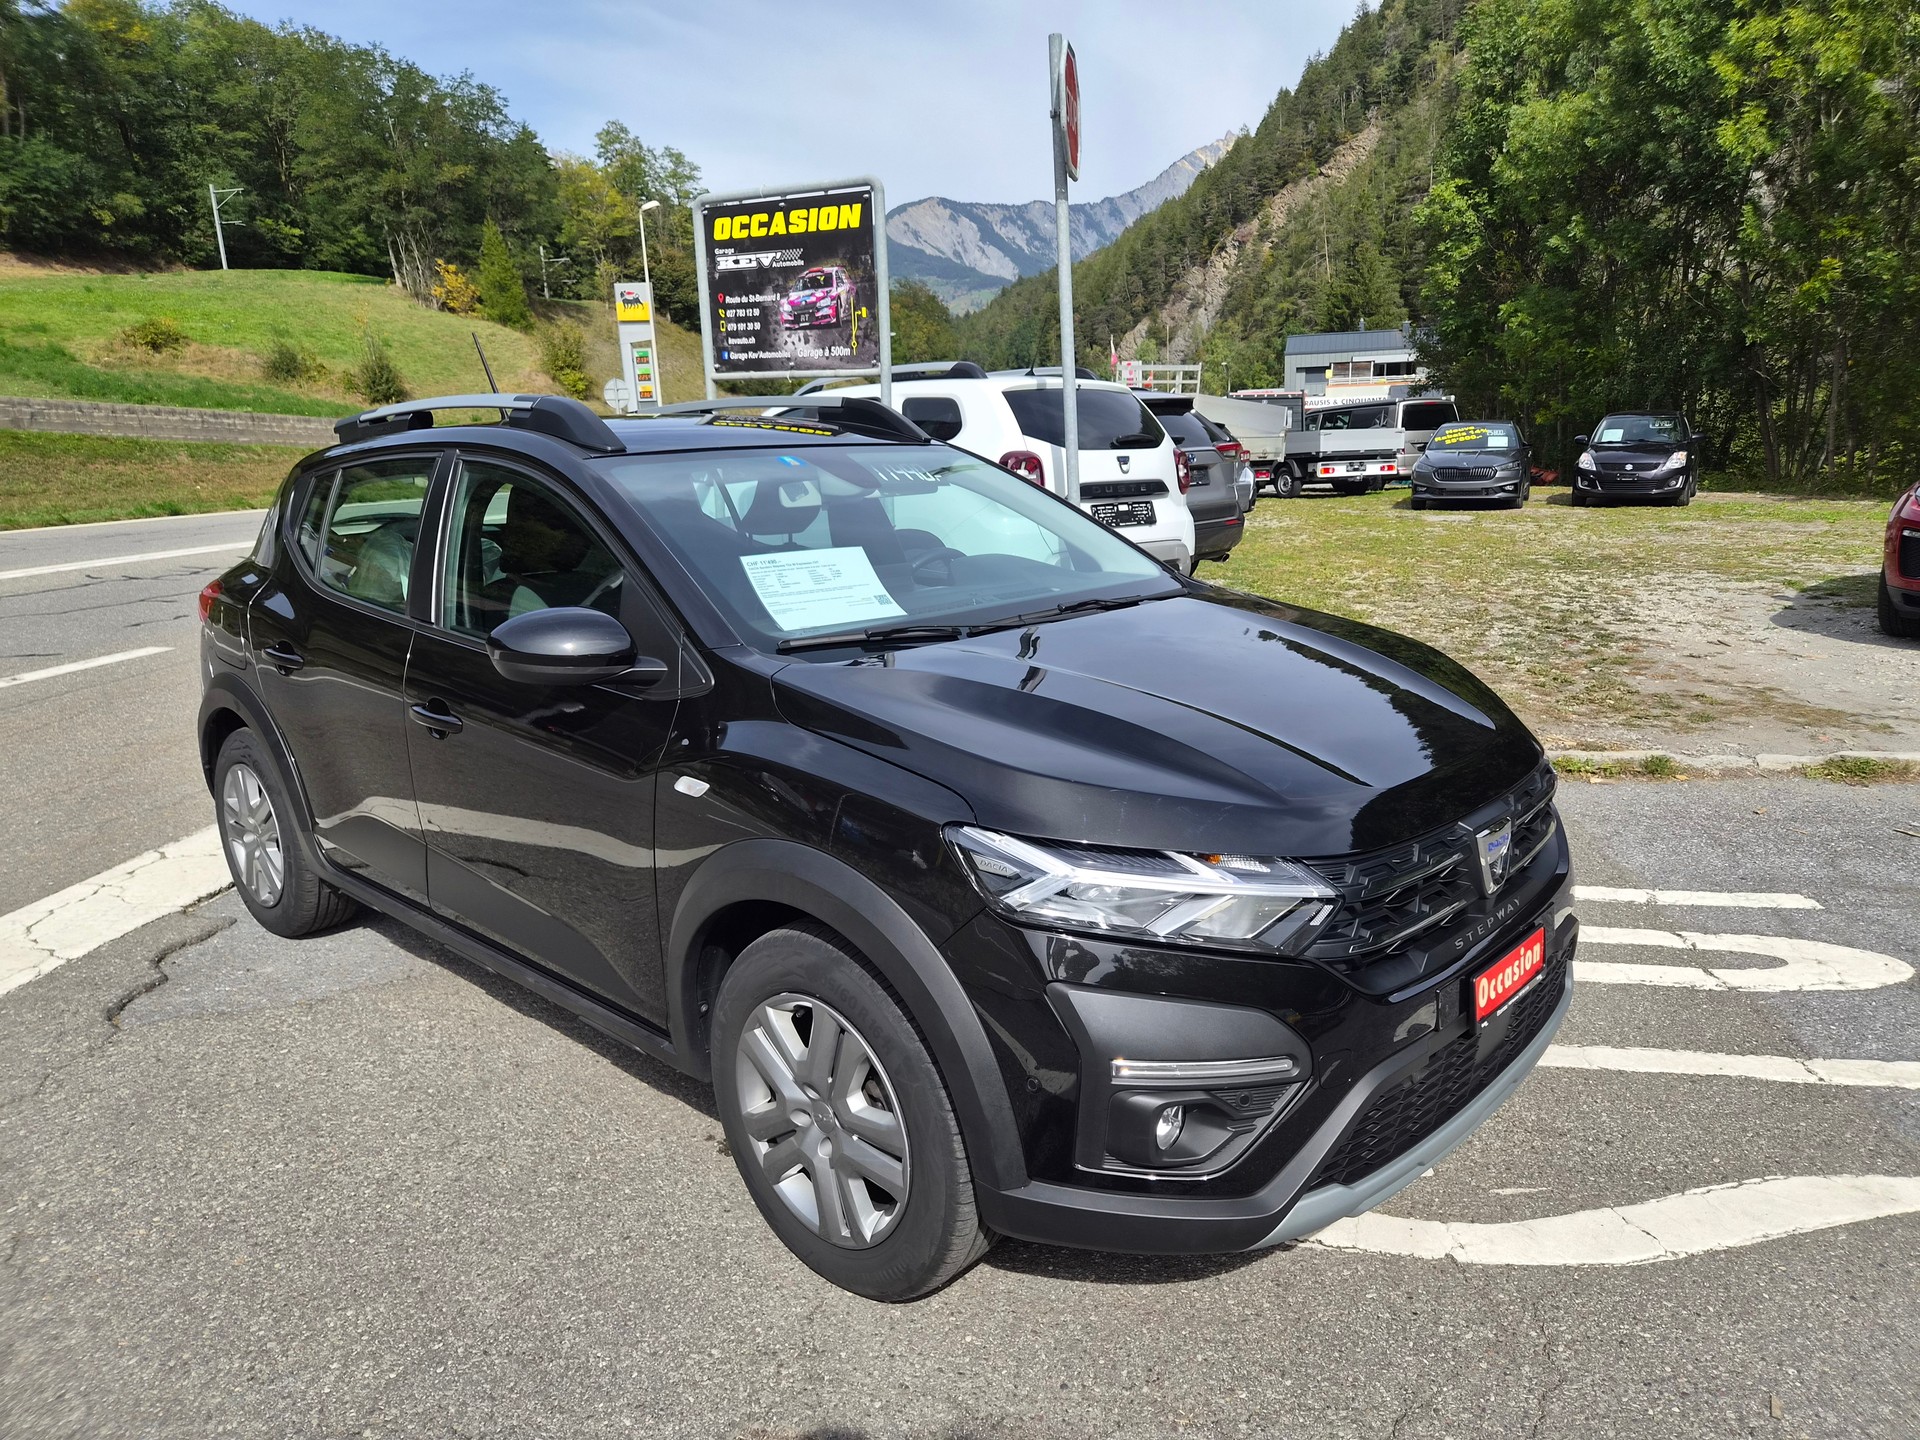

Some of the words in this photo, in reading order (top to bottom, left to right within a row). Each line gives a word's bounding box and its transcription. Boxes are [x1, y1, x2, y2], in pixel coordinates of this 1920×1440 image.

[713, 203, 863, 241] OCCASION
[772, 259, 805, 268] Automobile
[725, 295, 741, 304] Route
[741, 295, 748, 303] du
[748, 292, 776, 303] St-Bernard
[729, 352, 748, 361] Garage
[797, 347, 824, 359] Garage
[830, 346, 851, 357] 500m
[979, 859, 1009, 873] DACIA
[1454, 895, 1521, 950] STEPWAY
[1478, 941, 1541, 1009] Occasion
